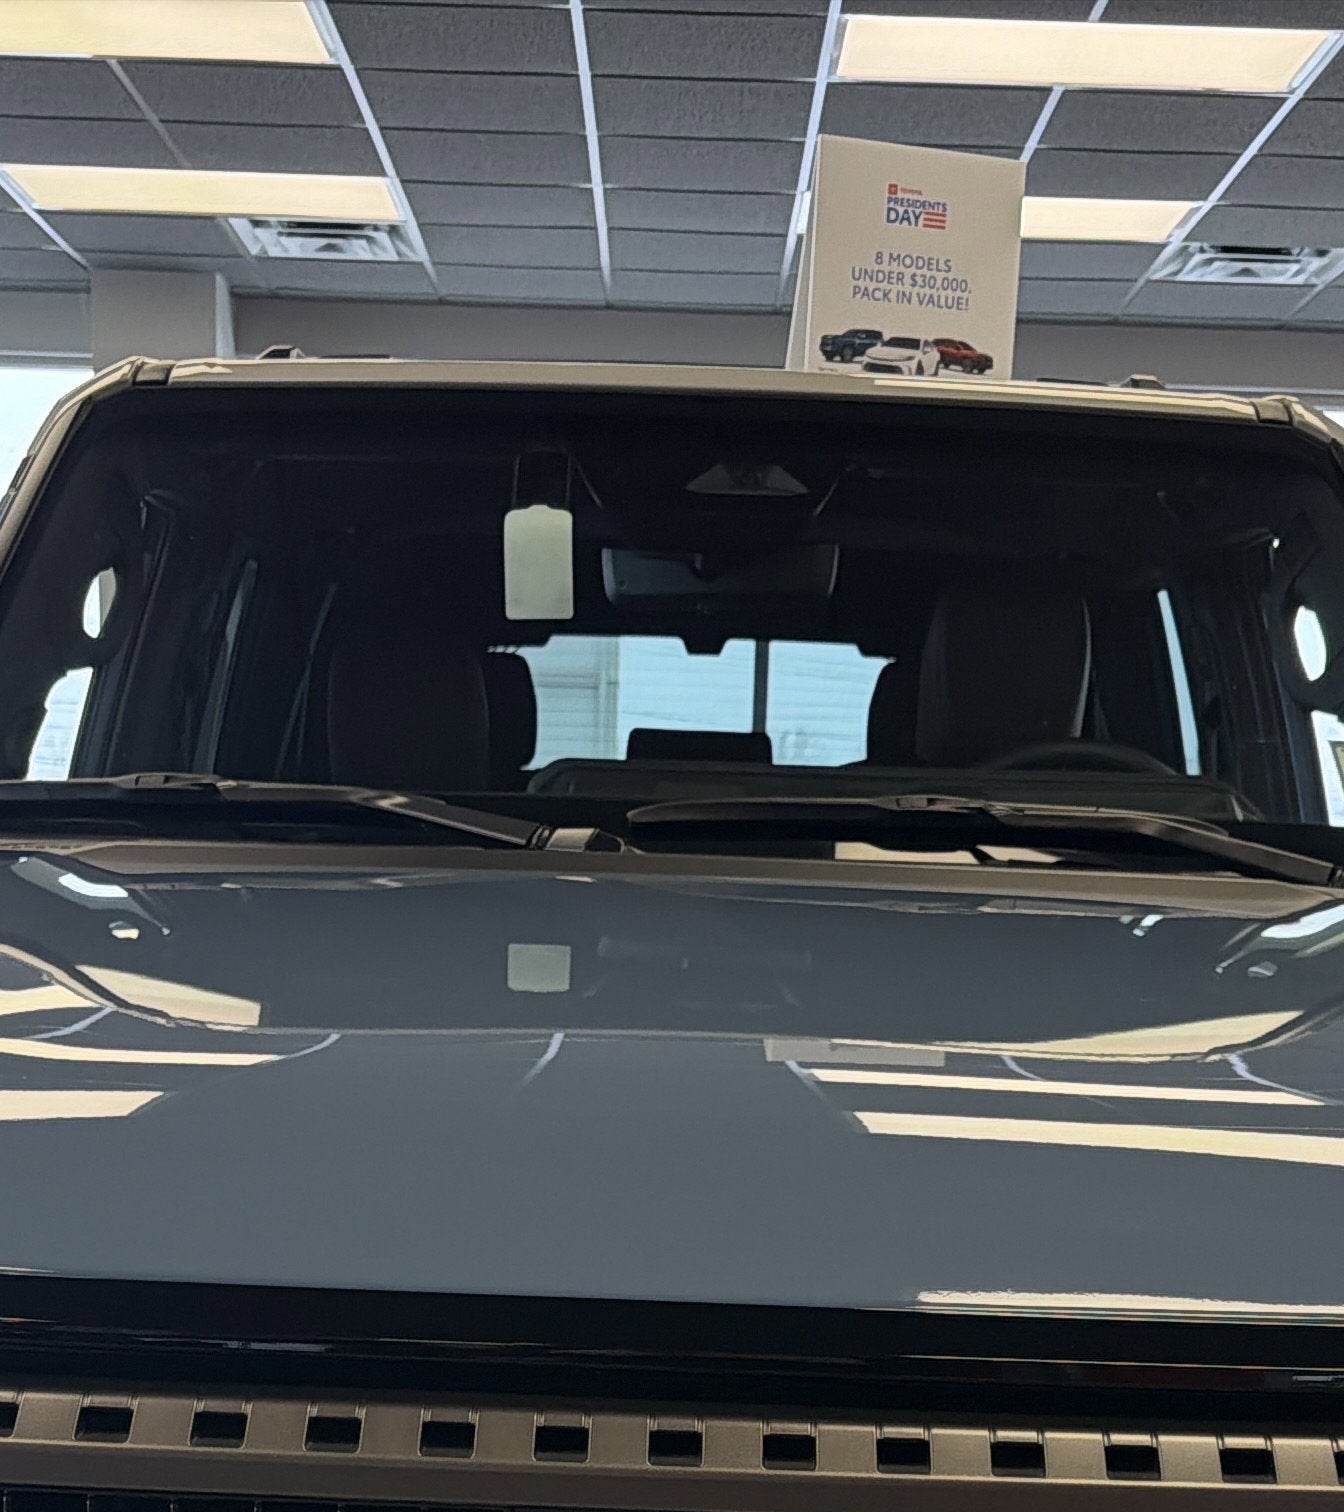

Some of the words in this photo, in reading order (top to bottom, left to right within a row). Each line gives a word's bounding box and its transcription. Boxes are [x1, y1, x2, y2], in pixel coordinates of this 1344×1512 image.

[886, 196, 948, 213] PRESIDENTS
[886, 207, 923, 228] DAY
[874, 251, 884, 265] 8
[888, 252, 953, 273] MODELS
[851, 266, 905, 284] UNDER
[909, 273, 972, 294] $30,000.
[852, 285, 892, 303] PACK
[896, 291, 912, 305] IN
[916, 293, 969, 312] VALUE!
